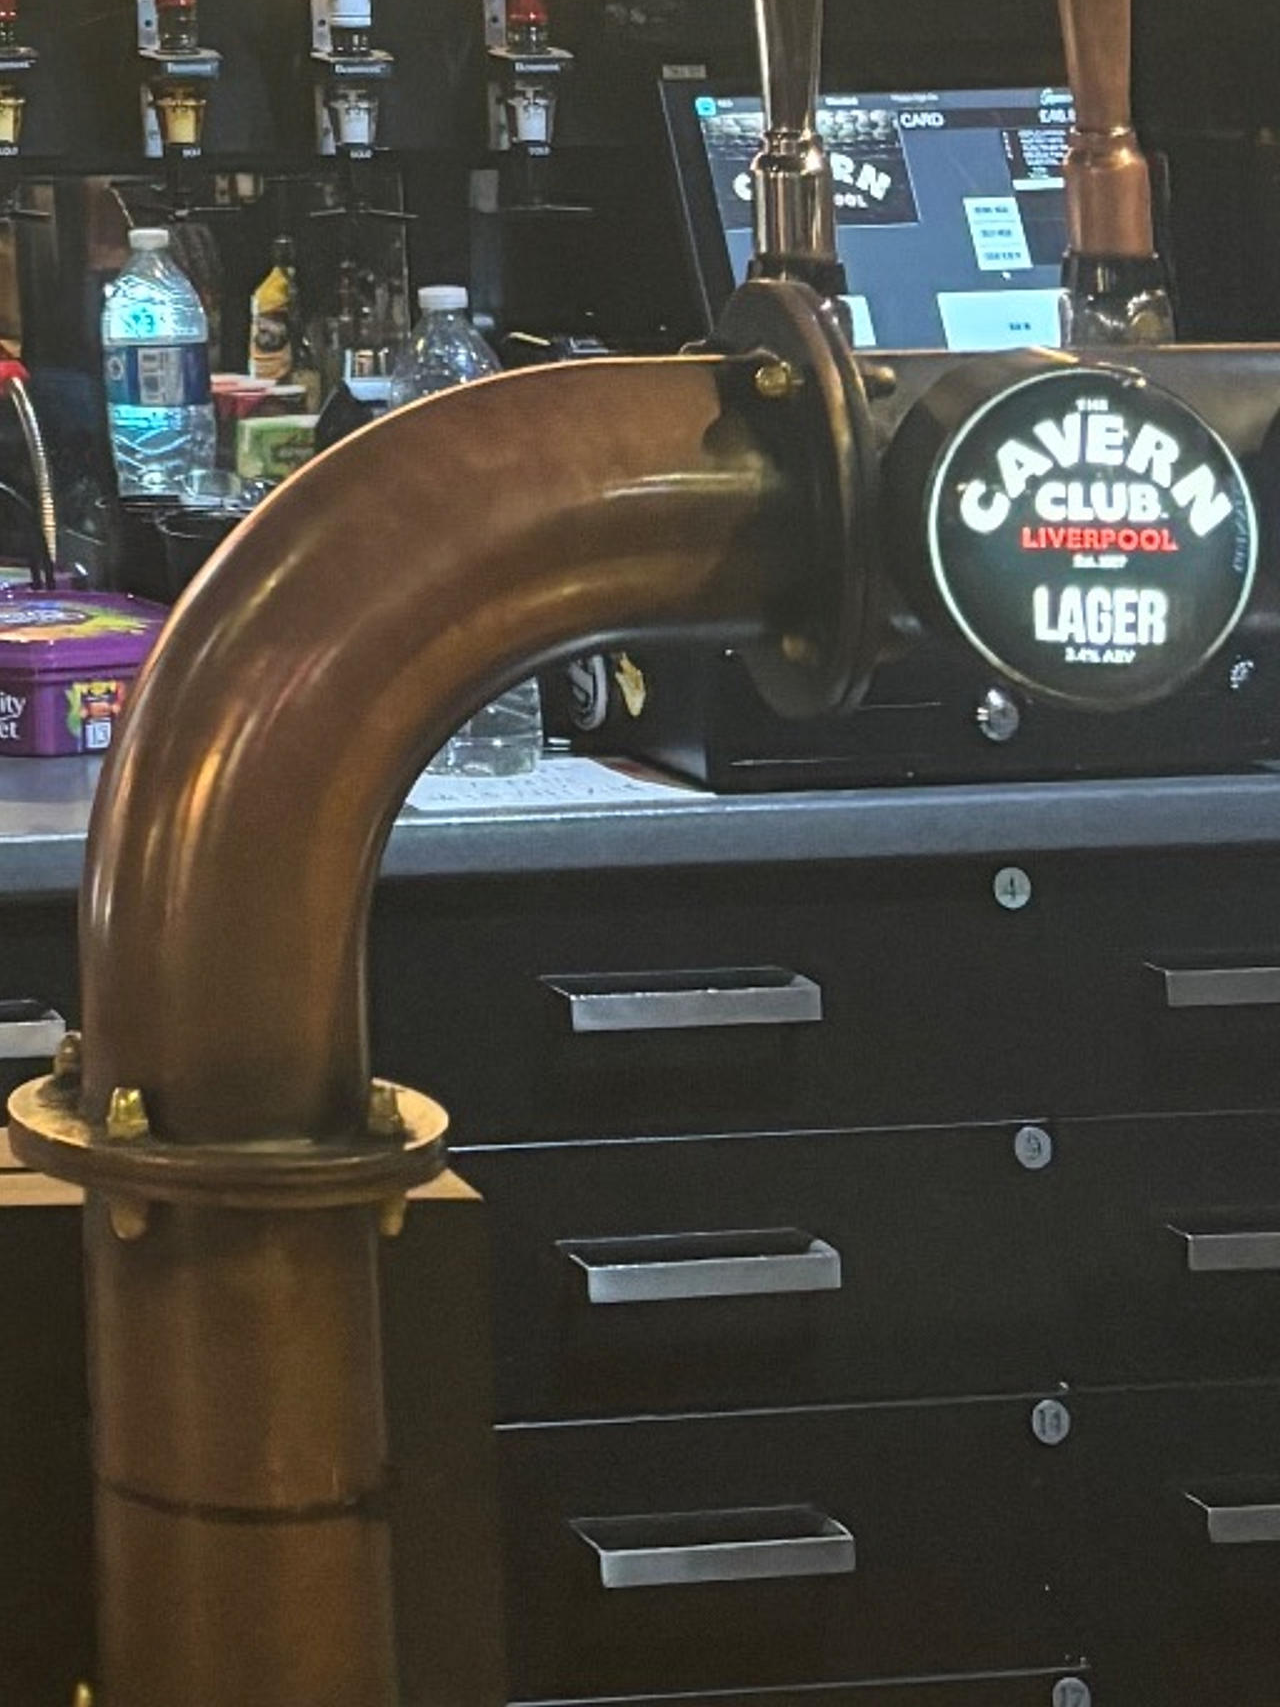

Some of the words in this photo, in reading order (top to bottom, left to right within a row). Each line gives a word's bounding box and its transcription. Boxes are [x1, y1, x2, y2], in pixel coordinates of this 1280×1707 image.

[900, 112, 944, 129] CARD
[1075, 398, 1109, 412] THE
[959, 411, 1233, 538] CAVERN
[1035, 481, 1163, 523] CLUB
[1021, 526, 1179, 553] LIVERPOOL
[1033, 585, 1169, 645] LAGER
